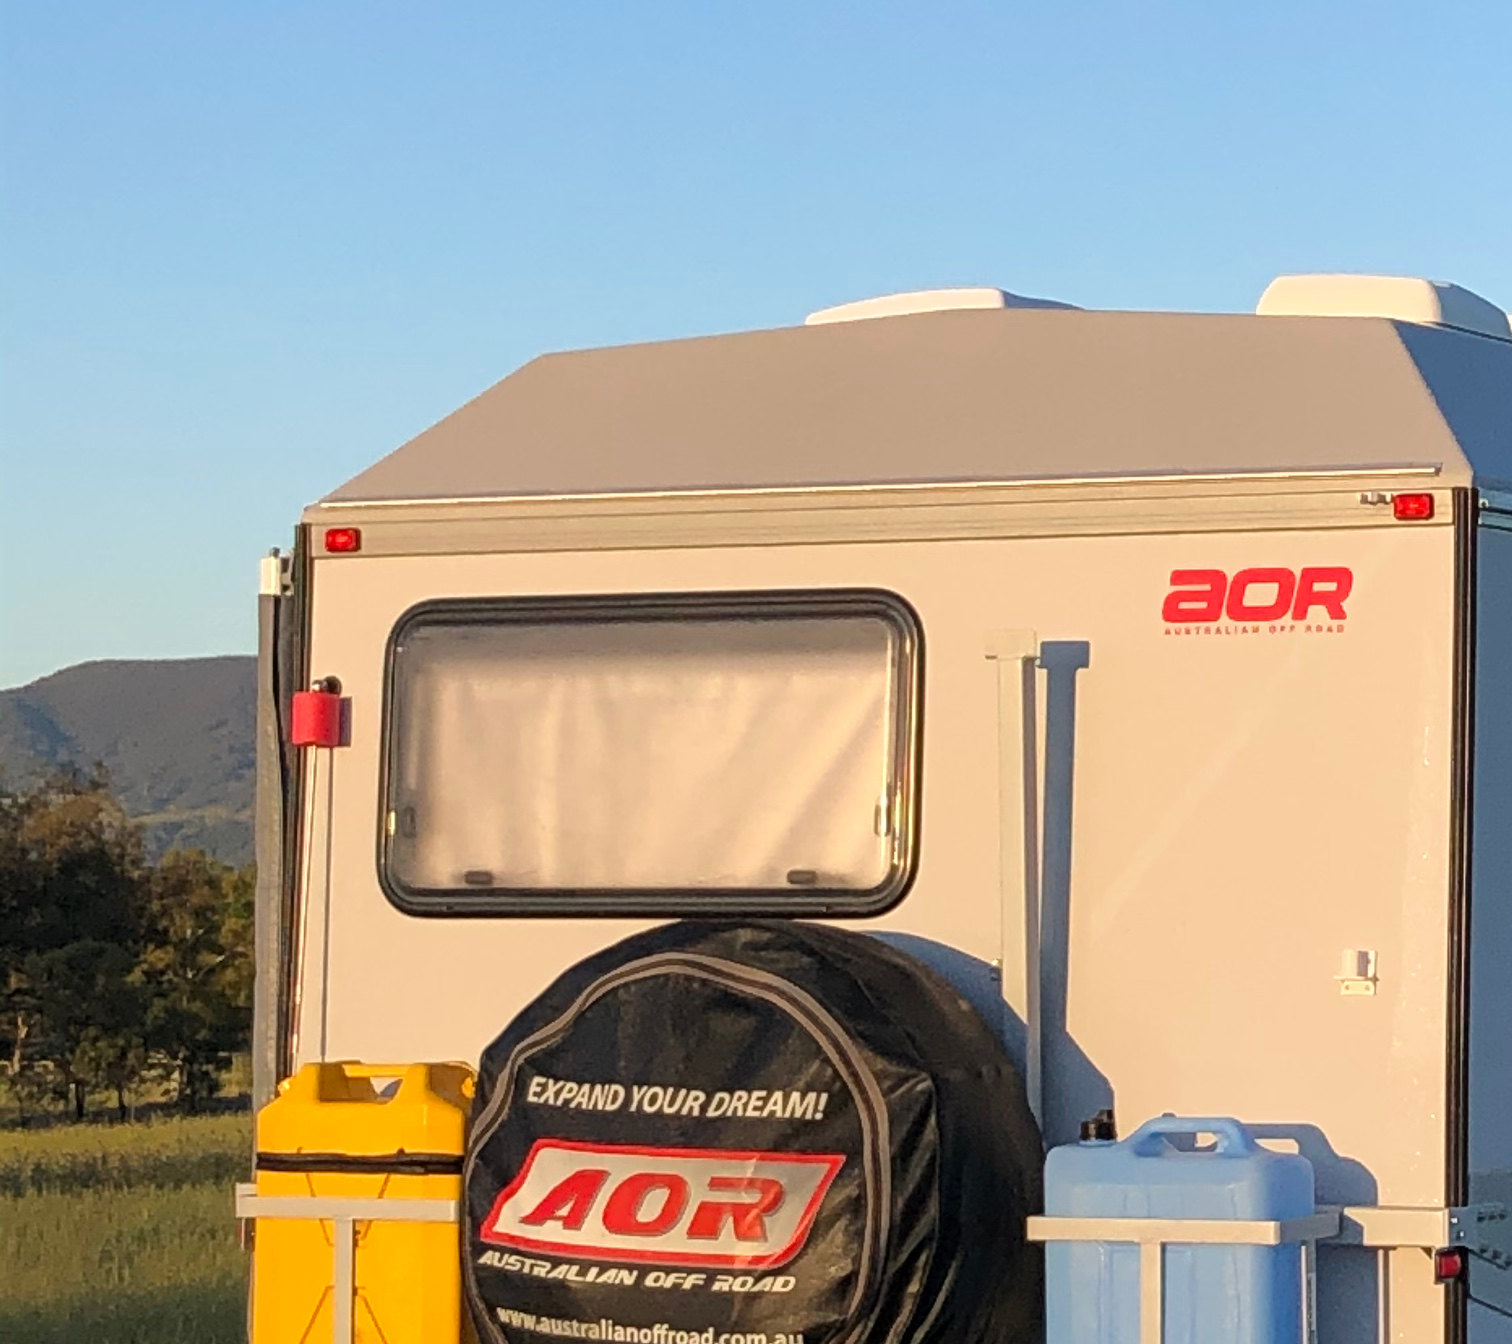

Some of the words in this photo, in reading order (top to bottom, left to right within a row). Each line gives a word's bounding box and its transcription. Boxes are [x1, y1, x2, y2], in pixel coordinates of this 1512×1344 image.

[1164, 625, 1260, 636] AUSTRALIAN
[1268, 624, 1296, 634] OFF
[1304, 624, 1345, 634] ROAD
[527, 1076, 625, 1112] EXPAND
[630, 1085, 705, 1117] YOUR
[706, 1089, 828, 1121] DREAM!
[518, 1169, 785, 1242] AOR
[477, 1250, 638, 1286] AUSTRALIAN
[644, 1270, 706, 1291] OFF
[711, 1274, 798, 1293] ROAD
